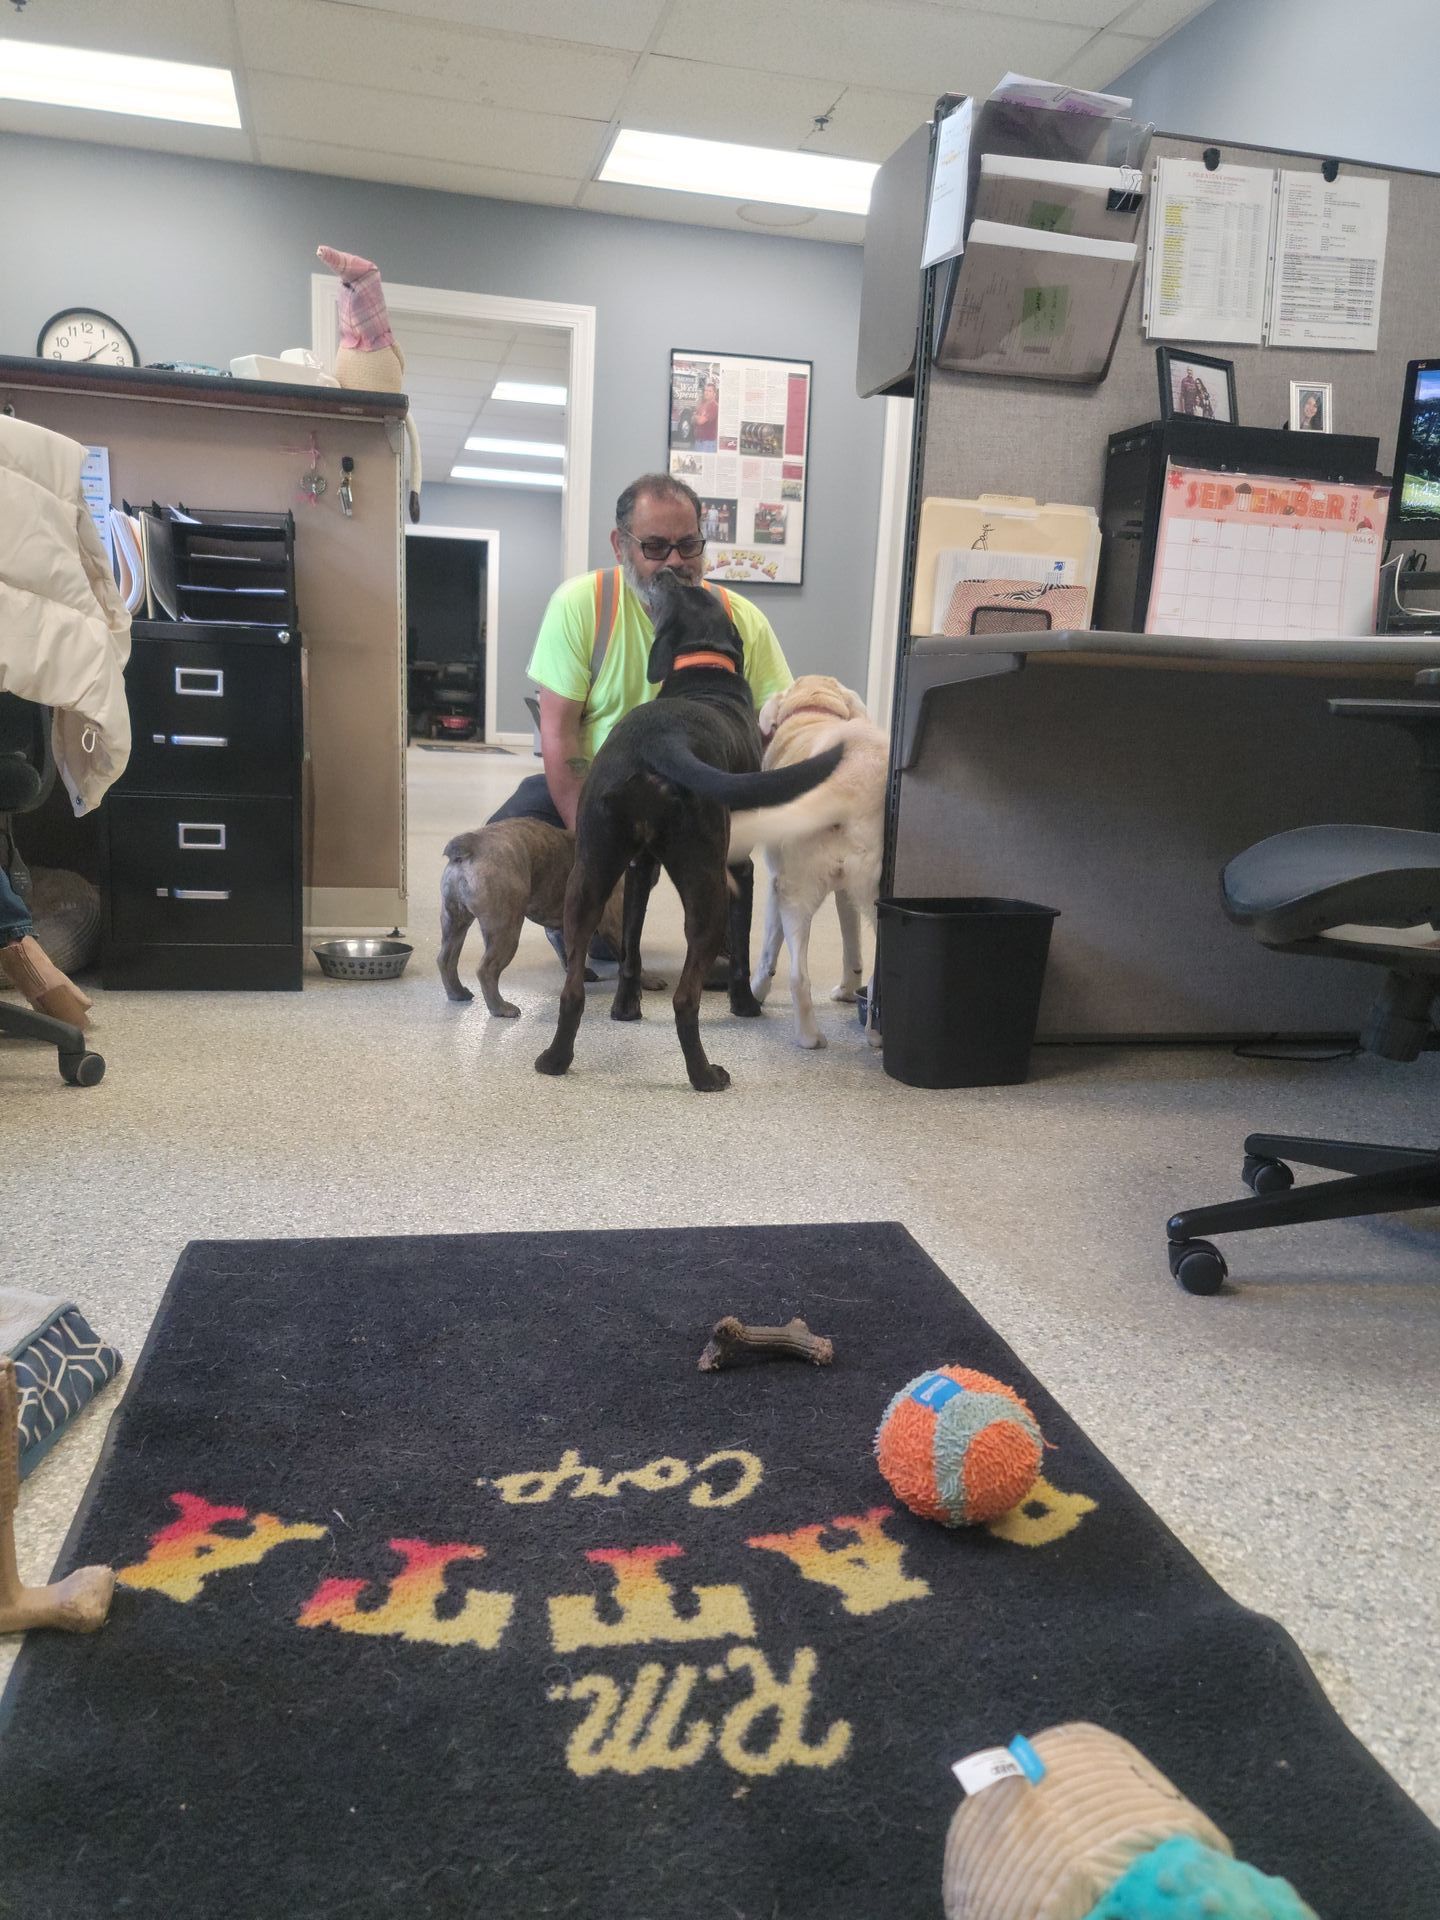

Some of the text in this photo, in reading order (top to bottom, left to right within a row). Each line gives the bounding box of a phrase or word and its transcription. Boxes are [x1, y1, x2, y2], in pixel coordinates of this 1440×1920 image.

[68, 326, 77, 336] 11
[81, 322, 94, 334] 12
[56, 336, 69, 348] 10
[111, 341, 119, 352] 2
[53, 351, 62, 360] 9
[115, 356, 125, 366] 3
[1185, 481, 1345, 520] SEPTEMBER
[474, 1449, 764, 1508] Corp.
[548, 1645, 850, 1776] R.M.
